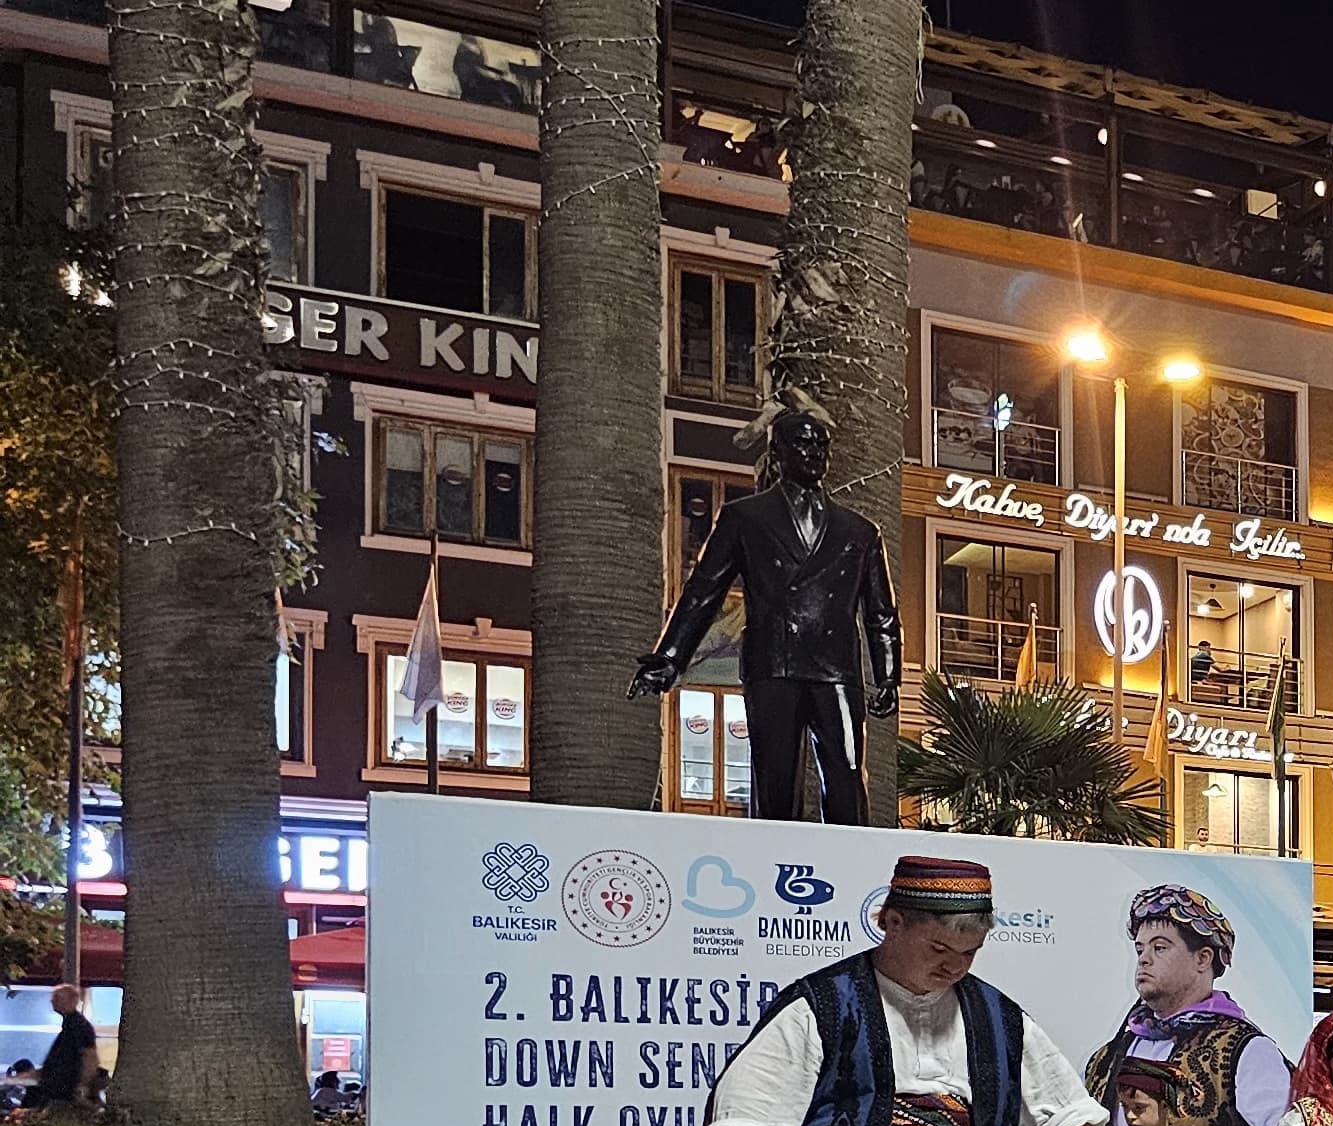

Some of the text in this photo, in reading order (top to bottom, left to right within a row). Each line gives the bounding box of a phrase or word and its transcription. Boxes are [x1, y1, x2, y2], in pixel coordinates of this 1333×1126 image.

[936, 474, 1044, 526] Kahve,
[1162, 513, 1211, 546] nda
[758, 917, 851, 942] BANDIRMA
[766, 943, 845, 958] BELEDİYESİ
[484, 972, 525, 1021] 2.
[484, 1037, 614, 1088] DOWN
